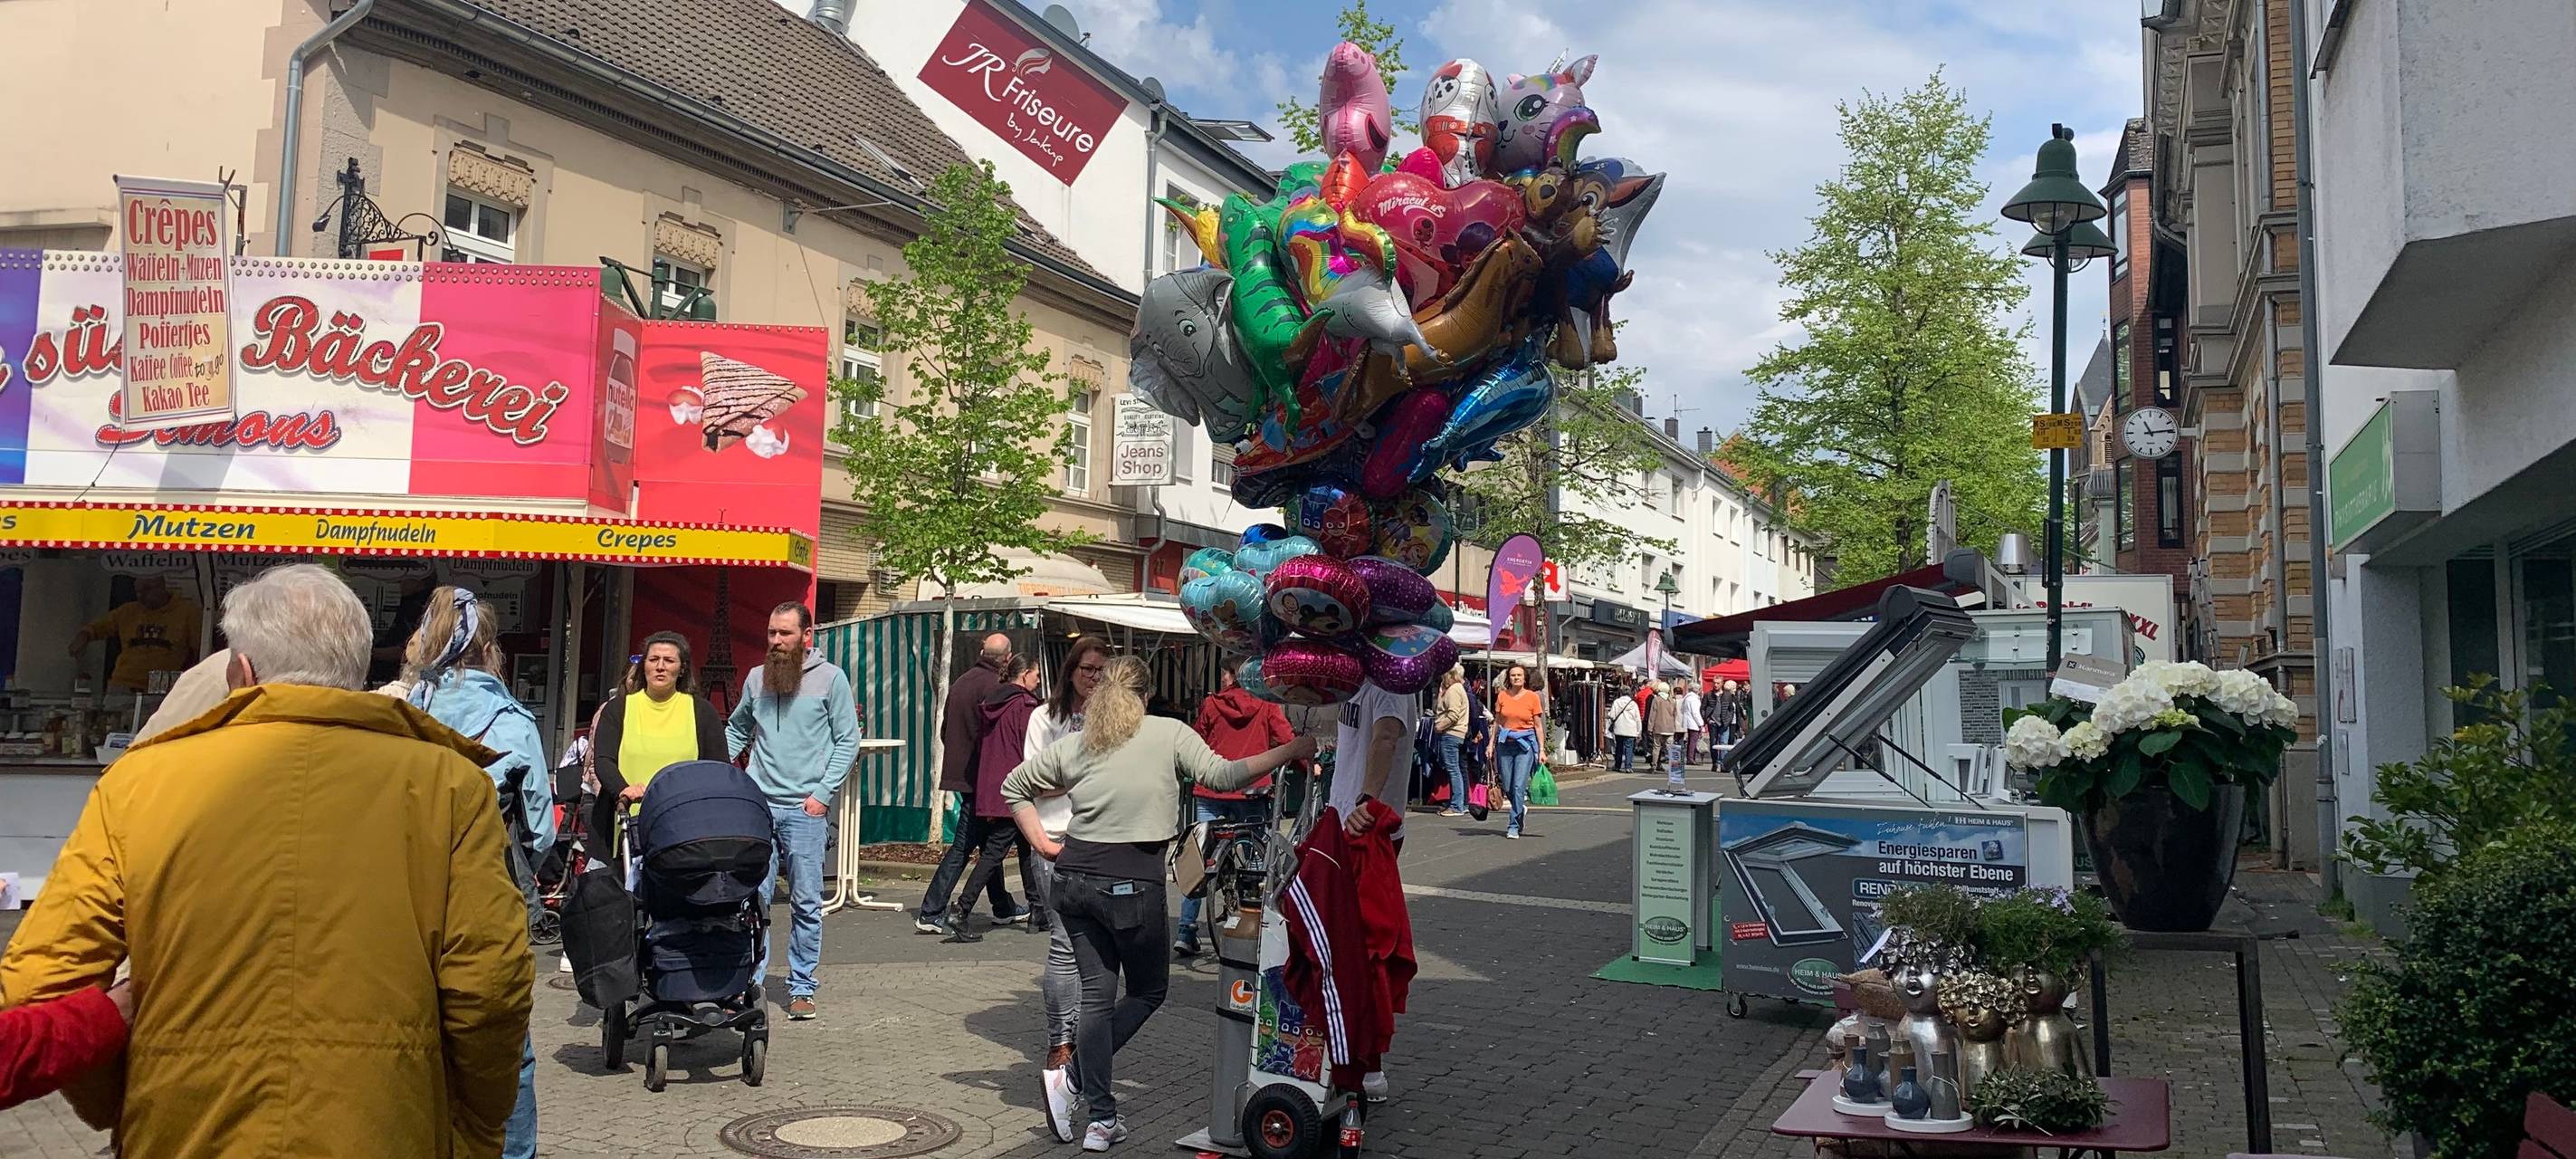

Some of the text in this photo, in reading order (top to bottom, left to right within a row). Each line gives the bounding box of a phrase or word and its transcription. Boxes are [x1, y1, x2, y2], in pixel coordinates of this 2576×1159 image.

[942, 43, 1094, 153] JR Friseure
[1007, 112, 1023, 138] by
[129, 198, 217, 252] Crêpes
[127, 254, 180, 282] Waffeln
[186, 254, 223, 281] Muzen
[127, 286, 224, 319] Dampfnudeln
[139, 320, 211, 350] Poffertjes
[130, 353, 167, 382] Kaffee
[169, 353, 194, 378] Coffee
[194, 362, 205, 378] to
[240, 293, 568, 445] Bäckerei
[142, 382, 210, 412] Kakao Tee
[607, 383, 634, 412] nutella
[1121, 445, 1164, 458] Jeans
[1122, 460, 1162, 476] Shop
[128, 513, 255, 540] Mutzen
[315, 518, 677, 551] Dampfnudeln Crepes
[106, 552, 187, 568] Waffeln
[1878, 841, 1977, 860] Energiesparen
[1879, 860, 2014, 881] auf höchster Ebene
[1646, 923, 1660, 931] HEIM
[1794, 969, 1813, 977] HEIM
